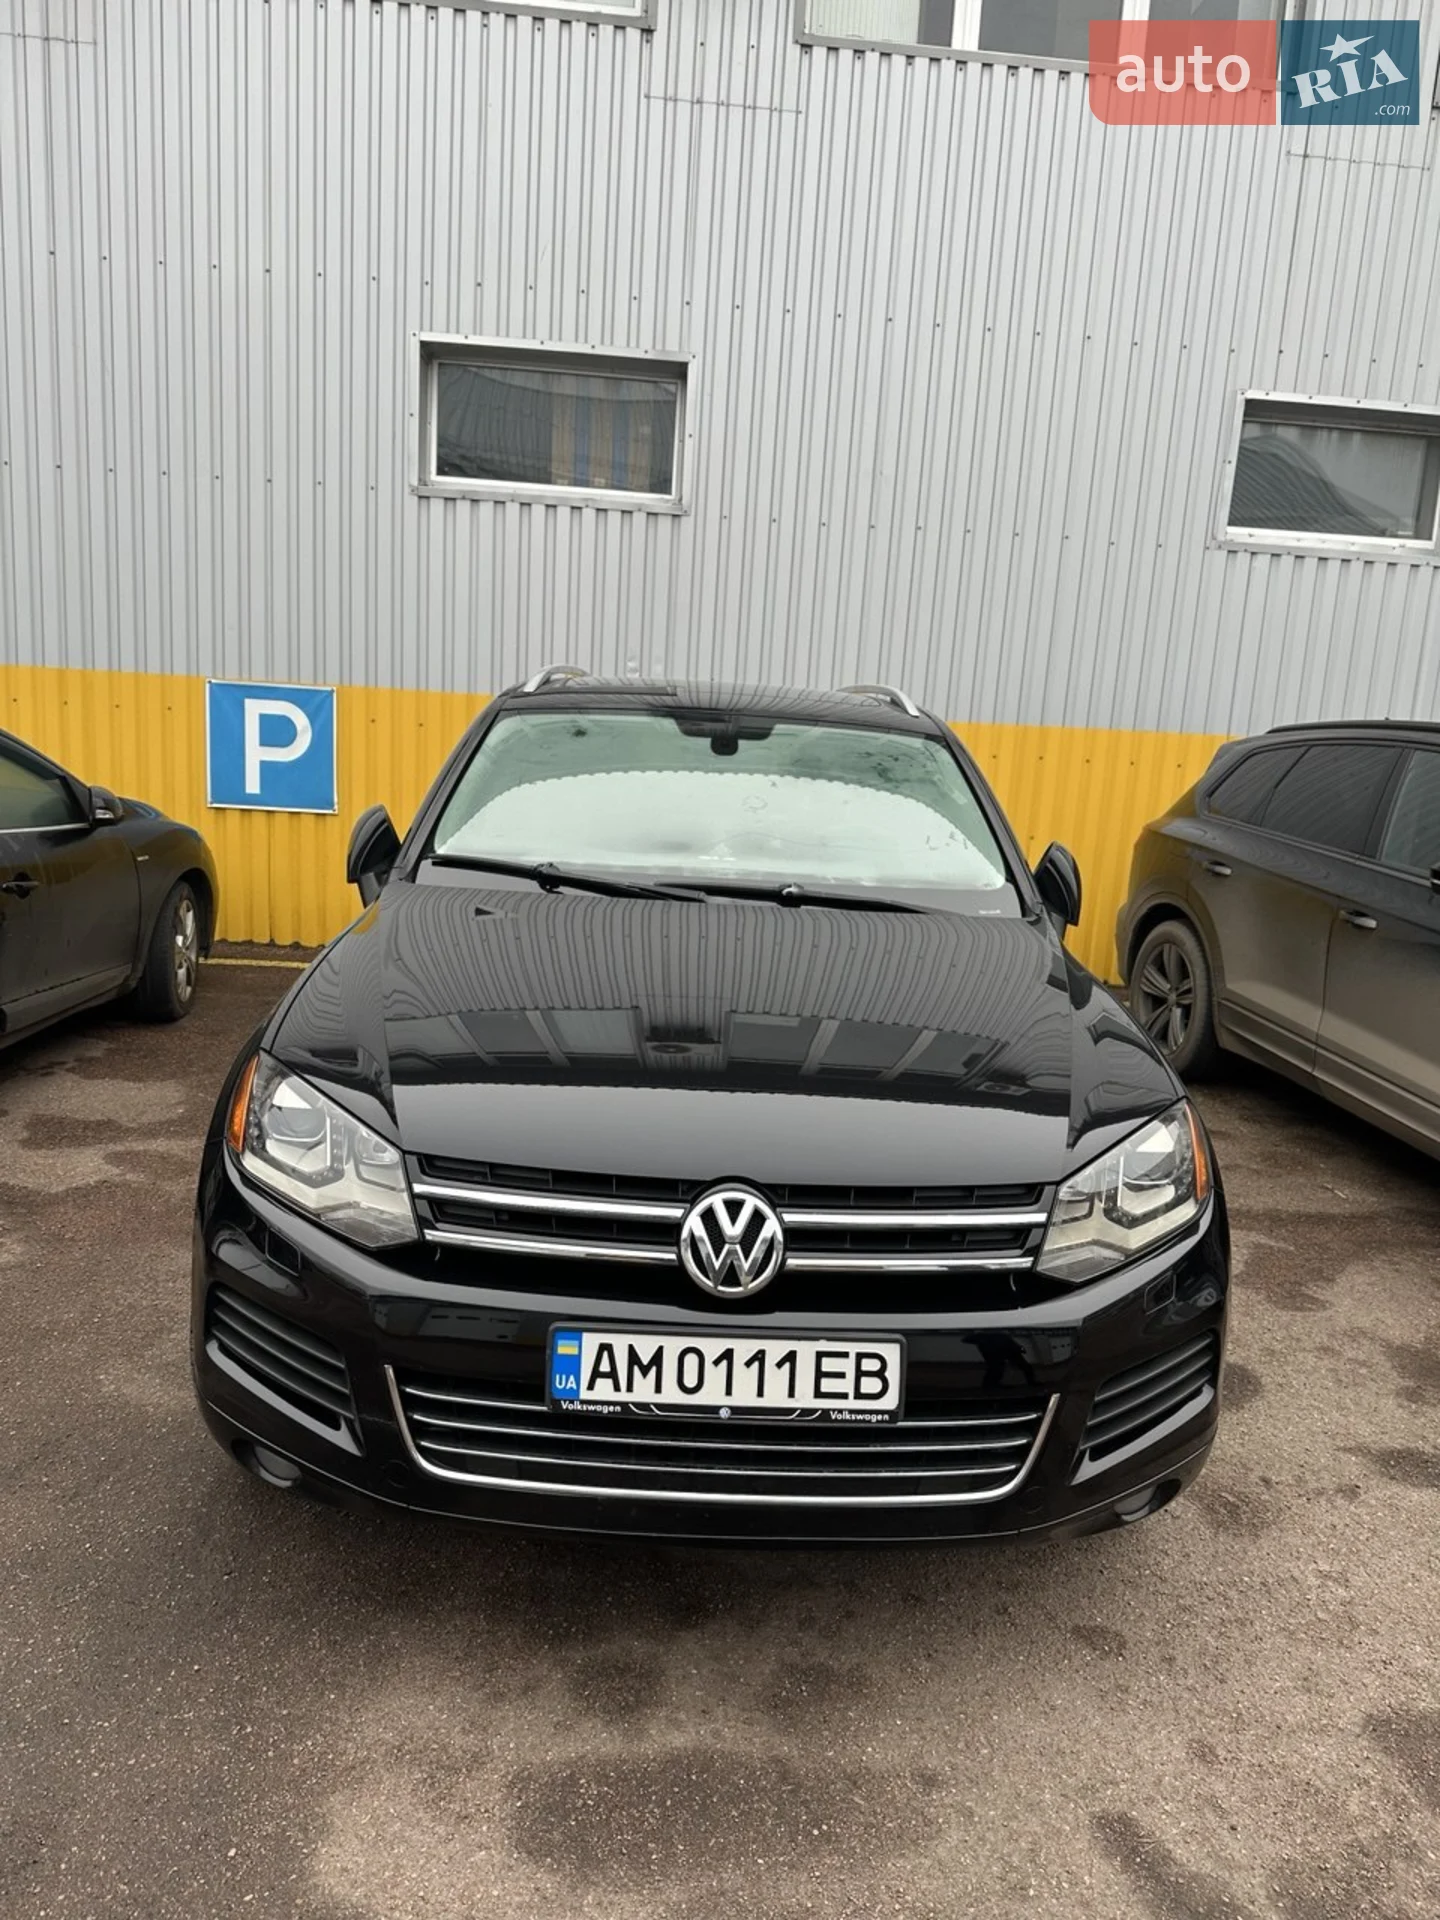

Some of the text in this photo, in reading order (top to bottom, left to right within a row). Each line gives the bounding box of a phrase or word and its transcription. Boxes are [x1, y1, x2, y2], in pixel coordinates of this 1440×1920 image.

[244, 698, 312, 794] P
[555, 1373, 577, 1390] UA
[560, 1400, 622, 1414] Volkswagen
[829, 1410, 890, 1423] Volkswagen
